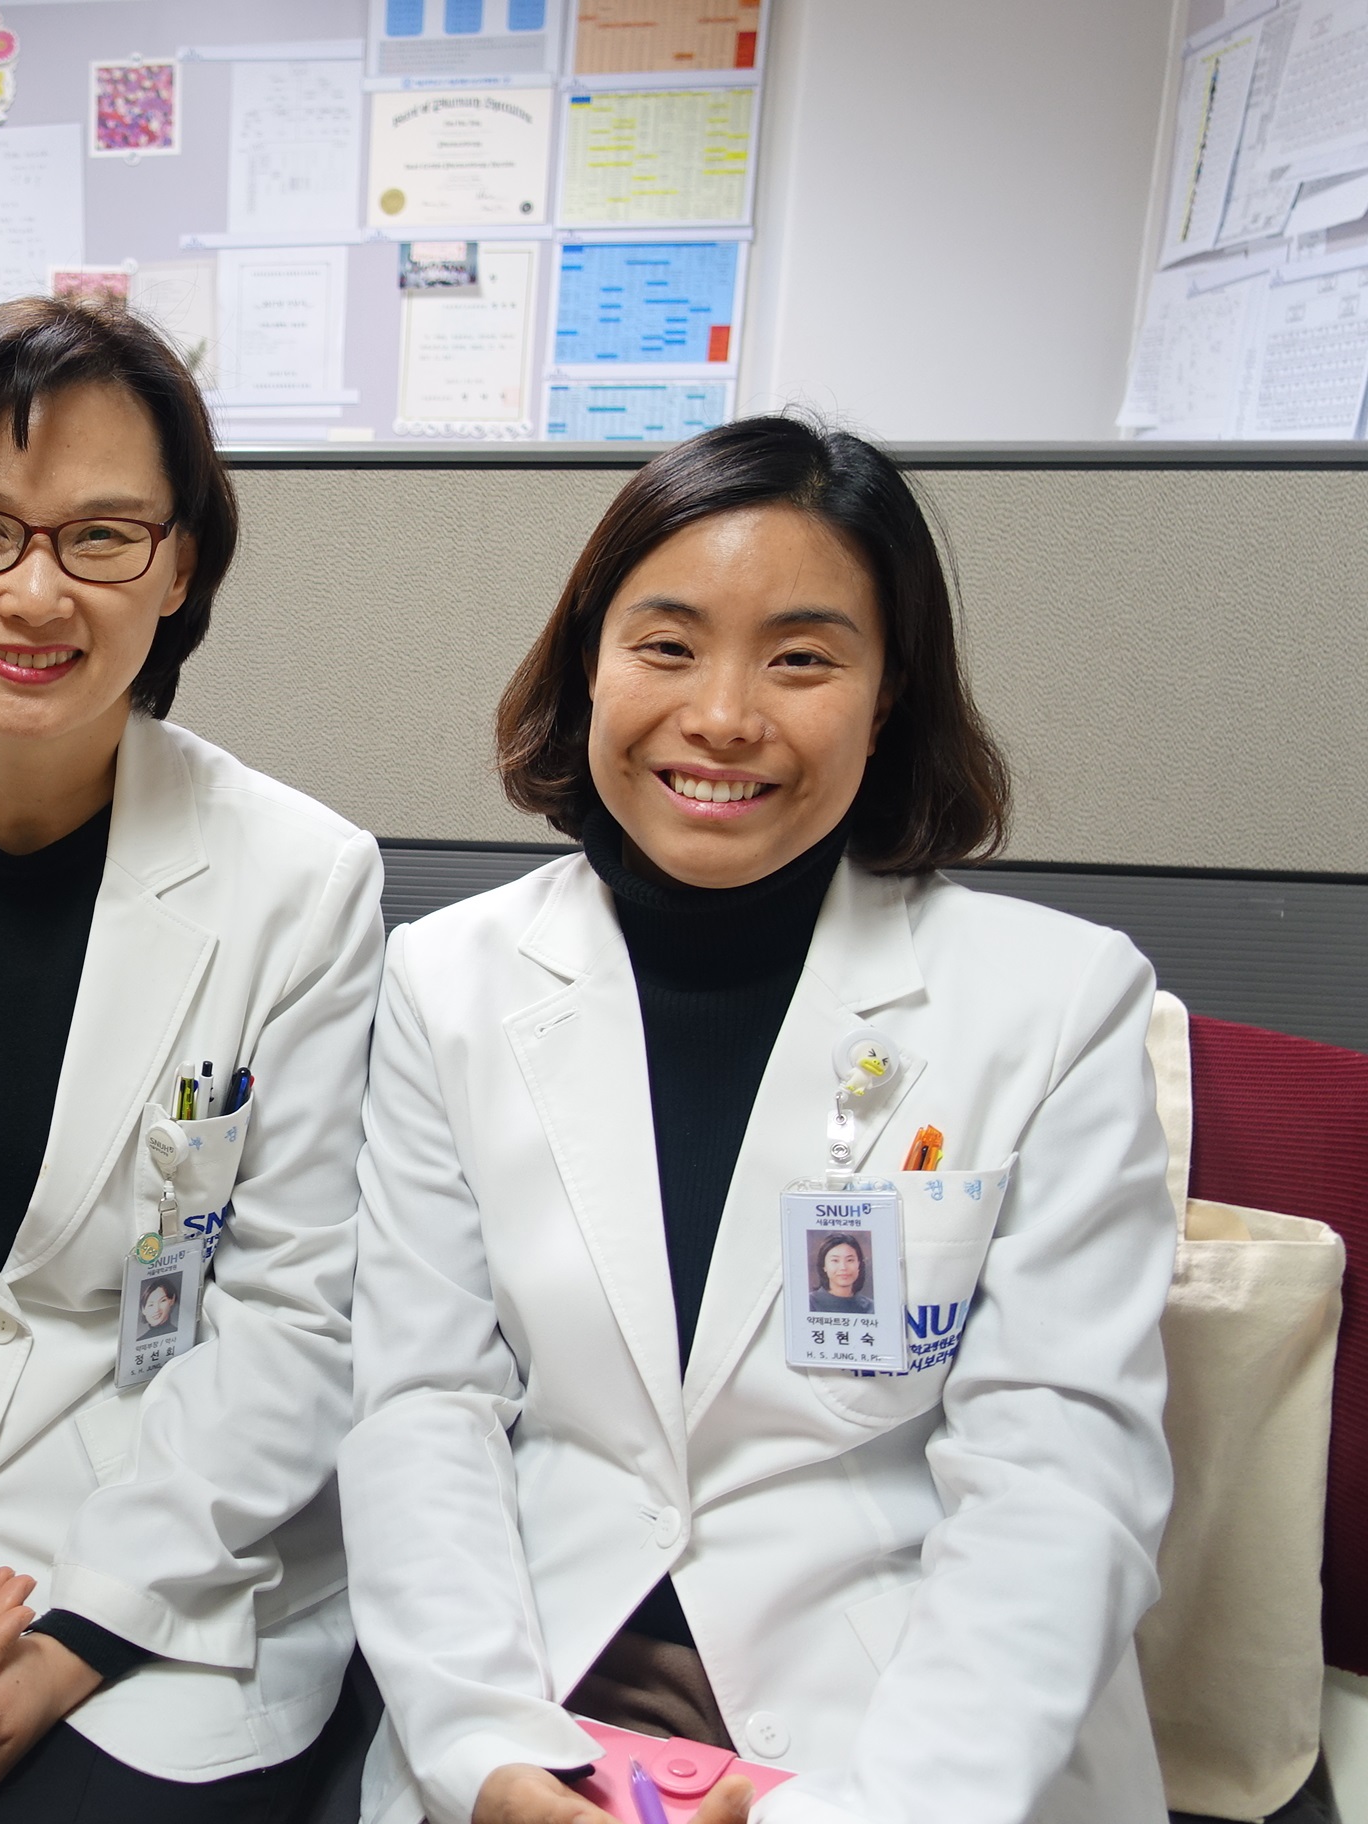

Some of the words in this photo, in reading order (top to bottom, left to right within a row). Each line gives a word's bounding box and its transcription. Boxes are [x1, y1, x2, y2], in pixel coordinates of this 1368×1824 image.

[816, 1204, 861, 1217] SNUH
[816, 1219, 861, 1227] 서울대학교병원
[860, 1318, 879, 1328] 약사
